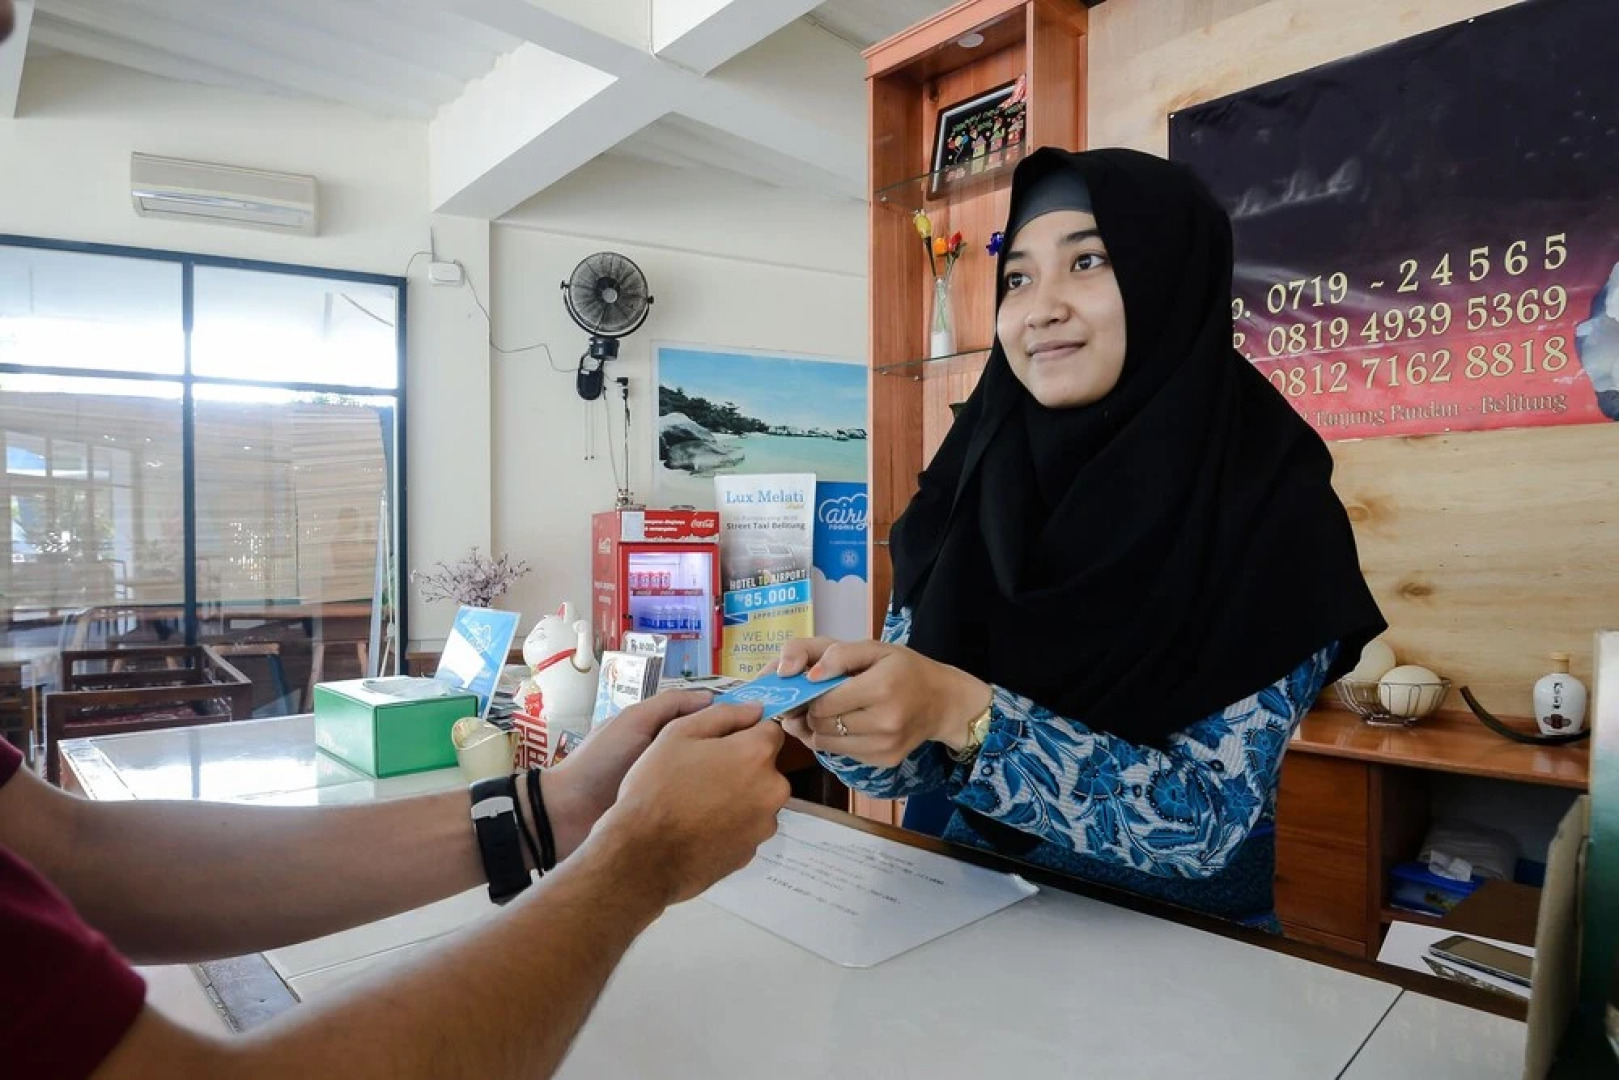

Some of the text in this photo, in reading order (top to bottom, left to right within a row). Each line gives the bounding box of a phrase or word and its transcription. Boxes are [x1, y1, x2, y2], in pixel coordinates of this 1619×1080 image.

[1267, 272, 1348, 314] 0719
[1267, 317, 1349, 356] 0819
[1359, 302, 1452, 344] 4939
[1466, 284, 1567, 331] 5369
[1268, 336, 1568, 396] 0812 7162 8818
[1313, 409, 1386, 429] Tanjung
[1390, 401, 1459, 421] Pandan
[1482, 393, 1567, 414] Belitung
[726, 489, 804, 504] Lux Melati
[726, 522, 750, 530] Street
[772, 522, 806, 531] Belitung
[729, 577, 757, 591] HOTEL
[743, 630, 793, 641] WE USE
[739, 663, 753, 673] Rp
